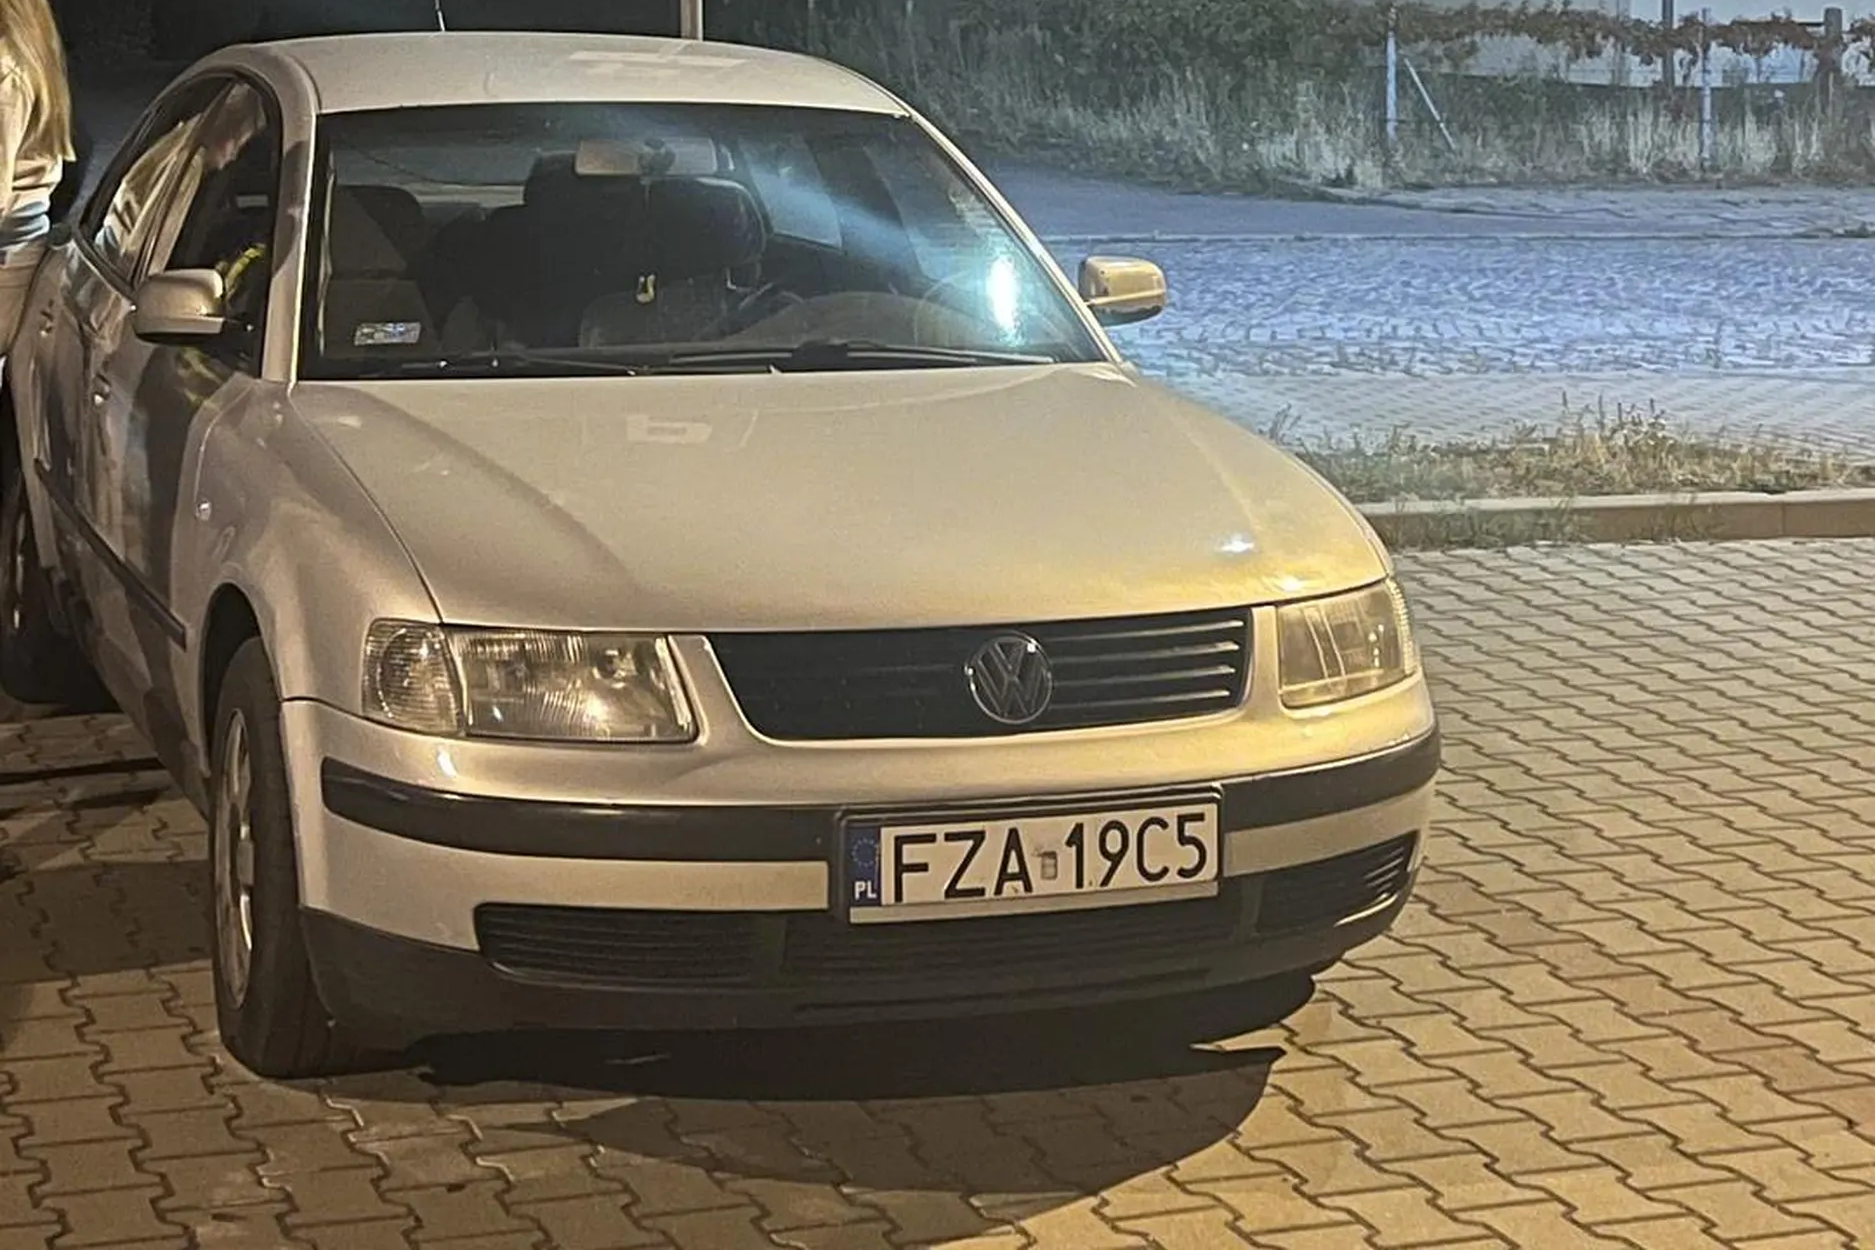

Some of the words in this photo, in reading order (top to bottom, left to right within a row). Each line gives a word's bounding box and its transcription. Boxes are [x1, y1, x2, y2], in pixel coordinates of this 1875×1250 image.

[973, 637, 1048, 720] VW
[854, 880, 878, 899] PL
[893, 827, 1034, 903] FZA
[1065, 811, 1207, 890] 19C5
